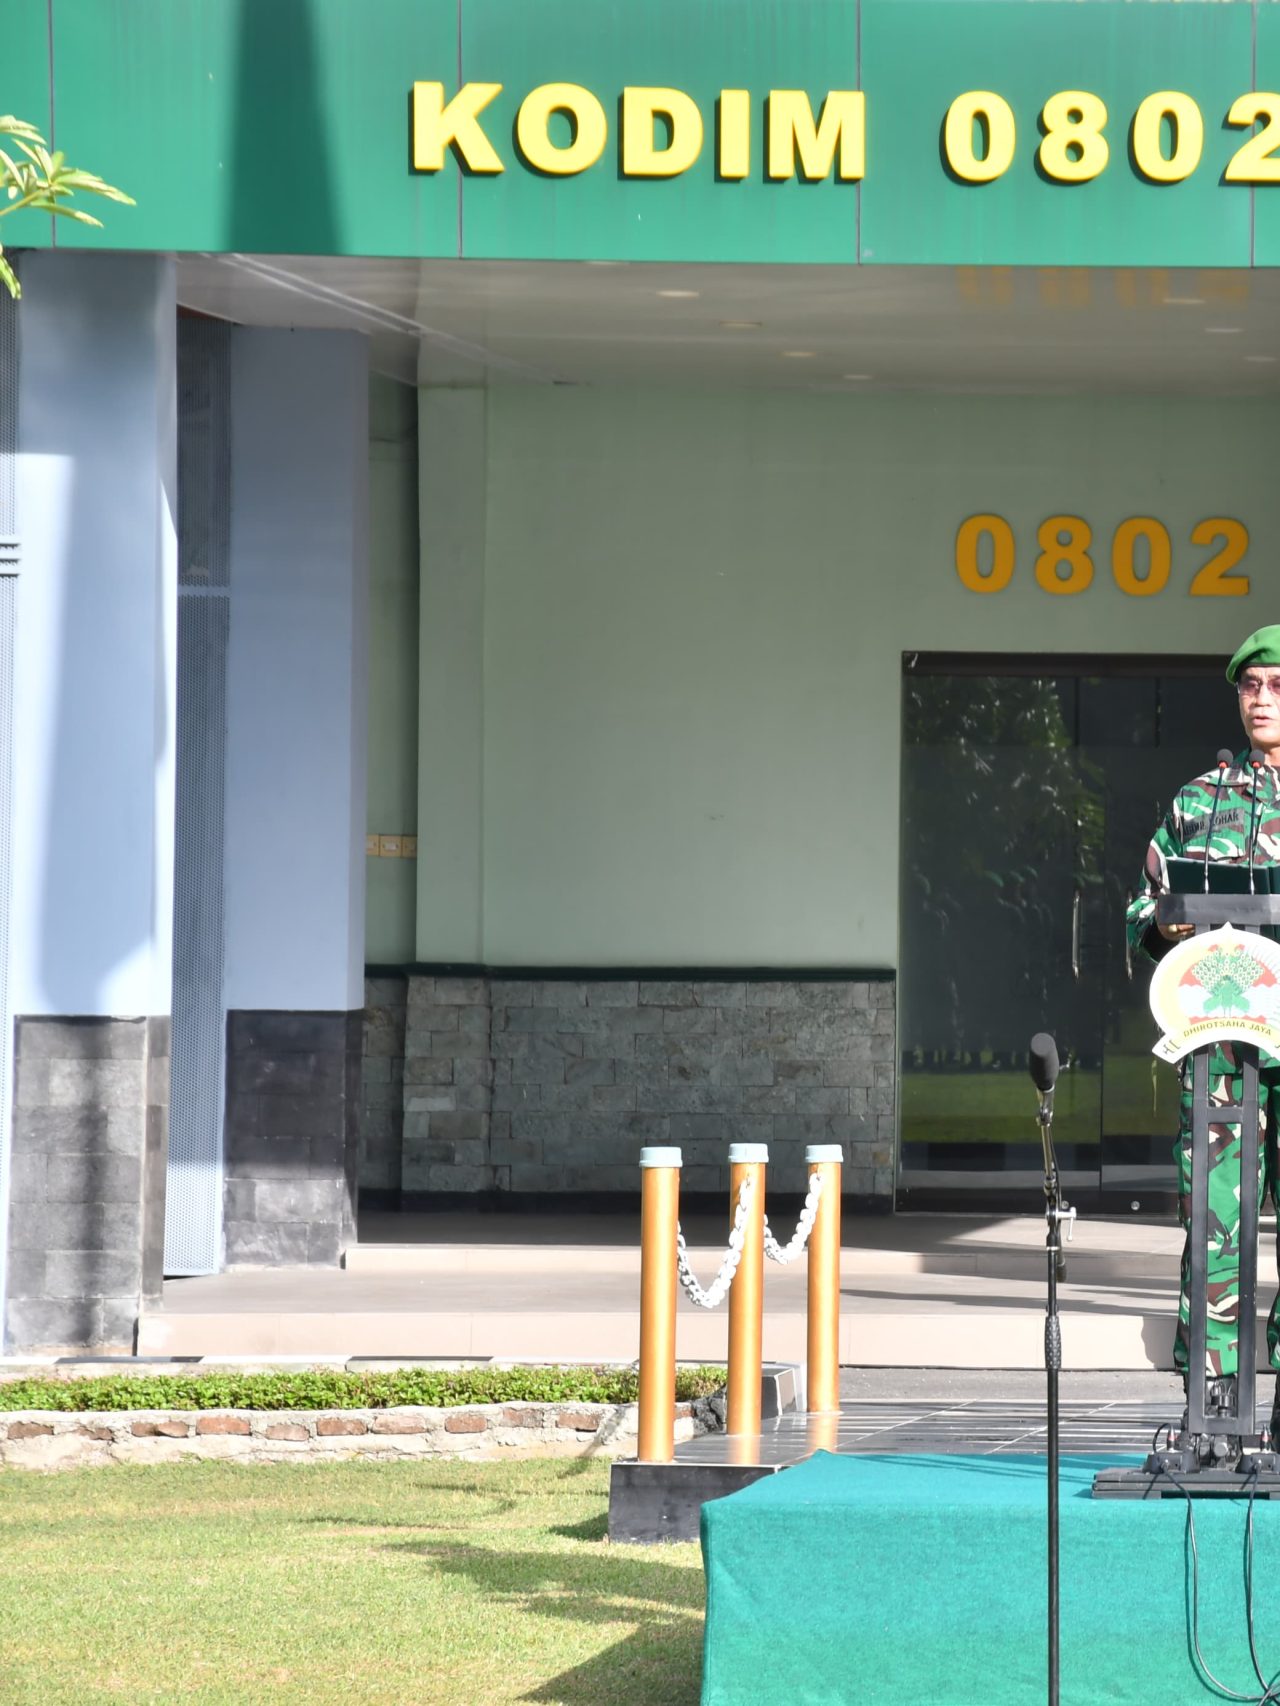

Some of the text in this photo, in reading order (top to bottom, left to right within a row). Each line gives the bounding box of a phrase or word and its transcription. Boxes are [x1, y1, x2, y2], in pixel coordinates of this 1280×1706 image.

[411, 80, 866, 180] KODIM
[955, 513, 1250, 597] 0802
[1183, 1020, 1272, 1038] DHIROTSAHA JAYA
